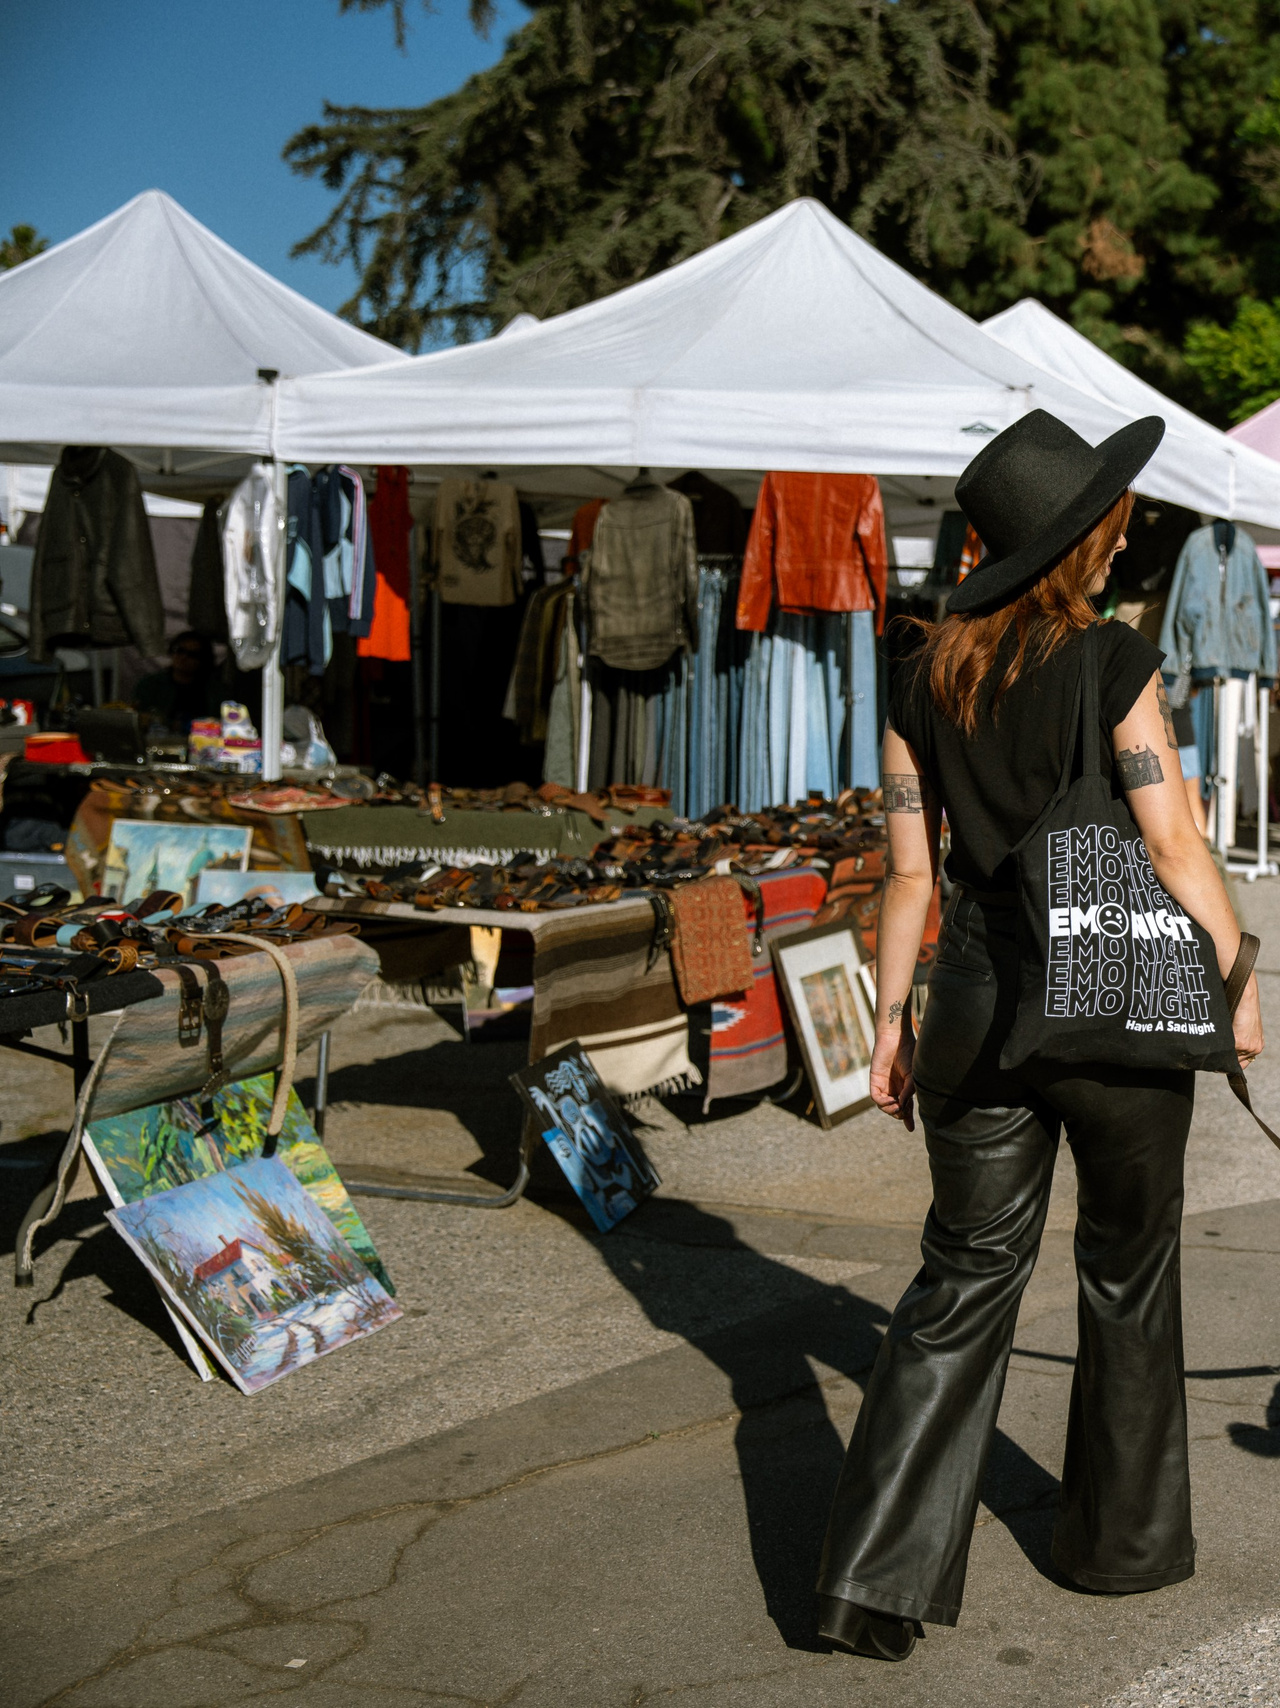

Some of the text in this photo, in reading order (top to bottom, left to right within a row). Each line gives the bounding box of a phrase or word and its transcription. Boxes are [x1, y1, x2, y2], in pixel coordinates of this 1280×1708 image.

[1048, 824, 1122, 860] EMO
[1048, 852, 1124, 885] EMO
[1048, 878, 1125, 909] EMO
[1048, 932, 1128, 963] EMO
[1047, 960, 1127, 990] EMO
[1045, 986, 1211, 1021] EMO NIGHT
[1125, 1019, 1216, 1036] Have A Sad Night
